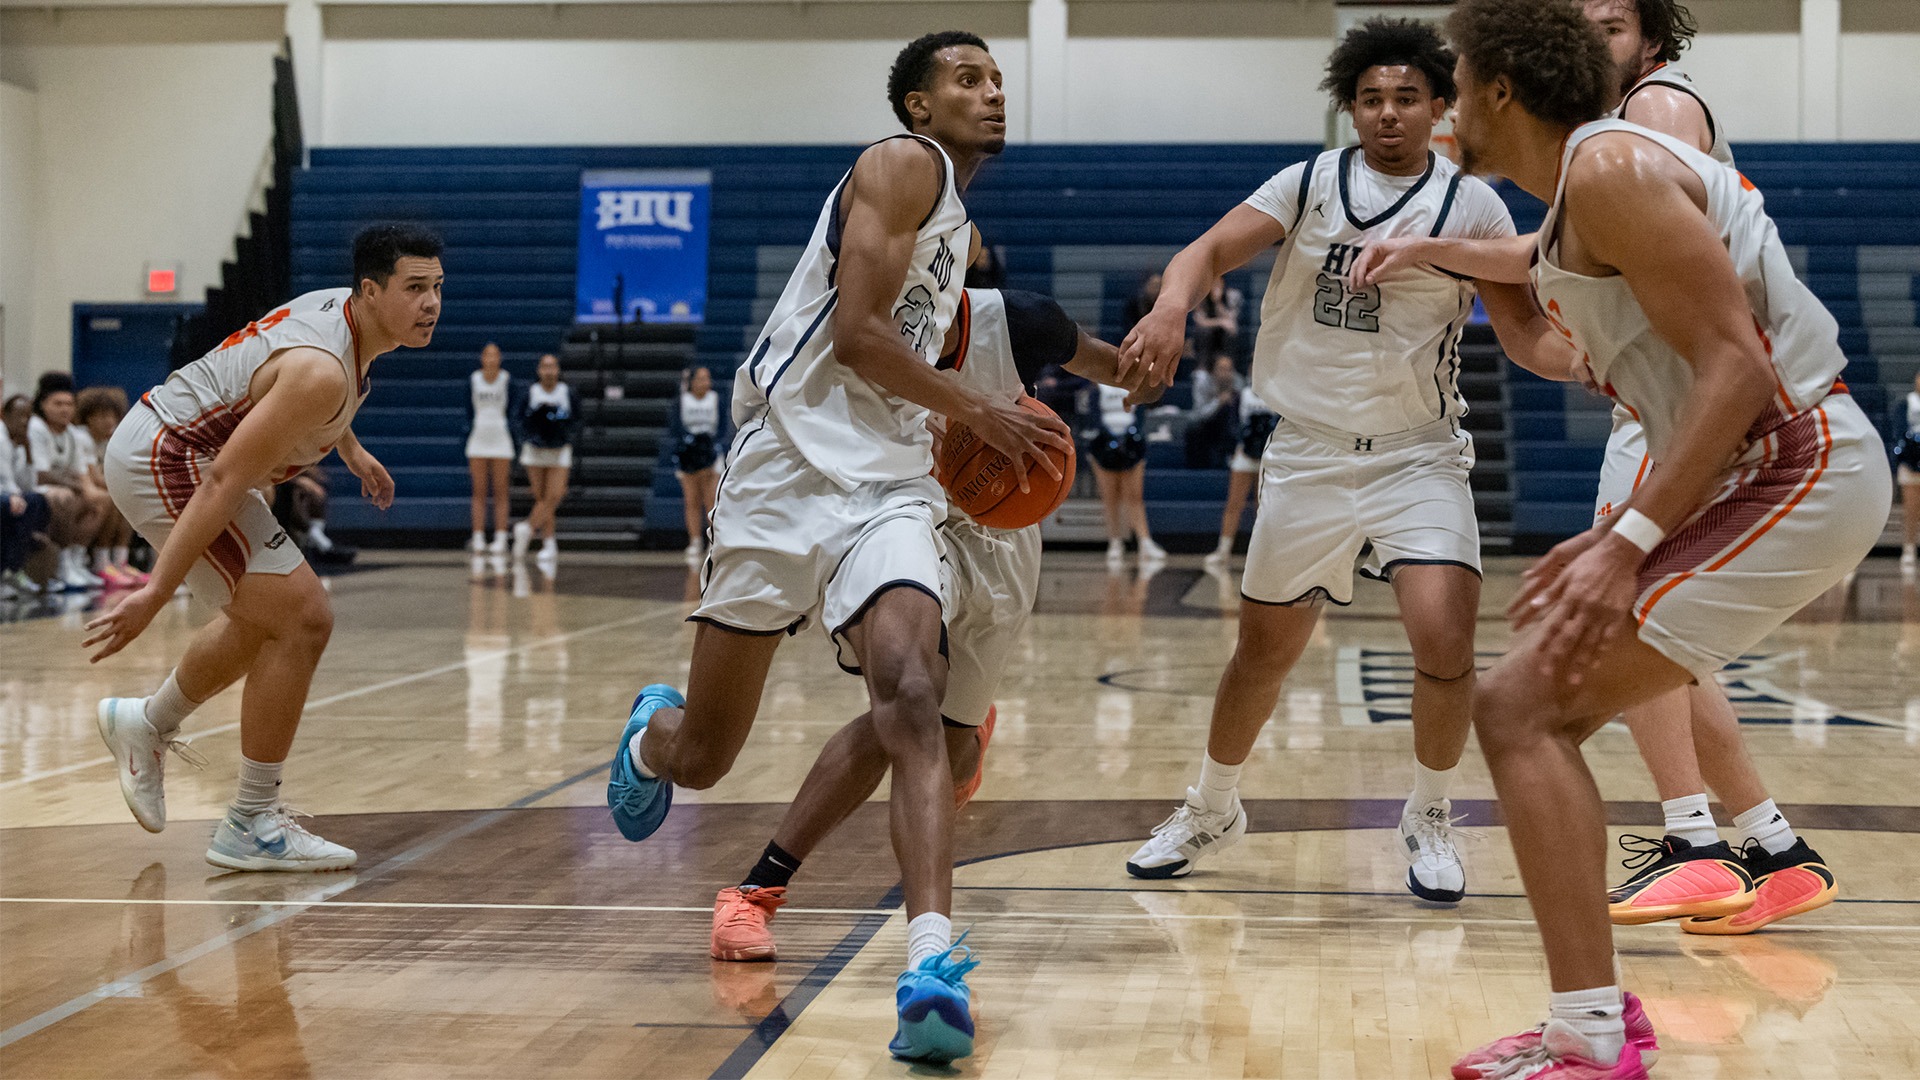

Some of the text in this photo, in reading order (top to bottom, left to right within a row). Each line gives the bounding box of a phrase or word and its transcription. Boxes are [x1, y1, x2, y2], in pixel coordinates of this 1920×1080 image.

[594, 191, 694, 232] HIU
[927, 235, 955, 293] HIU
[1313, 273, 1381, 333] 22
[1354, 437, 1373, 452] H
[956, 454, 1013, 507] PALDING
